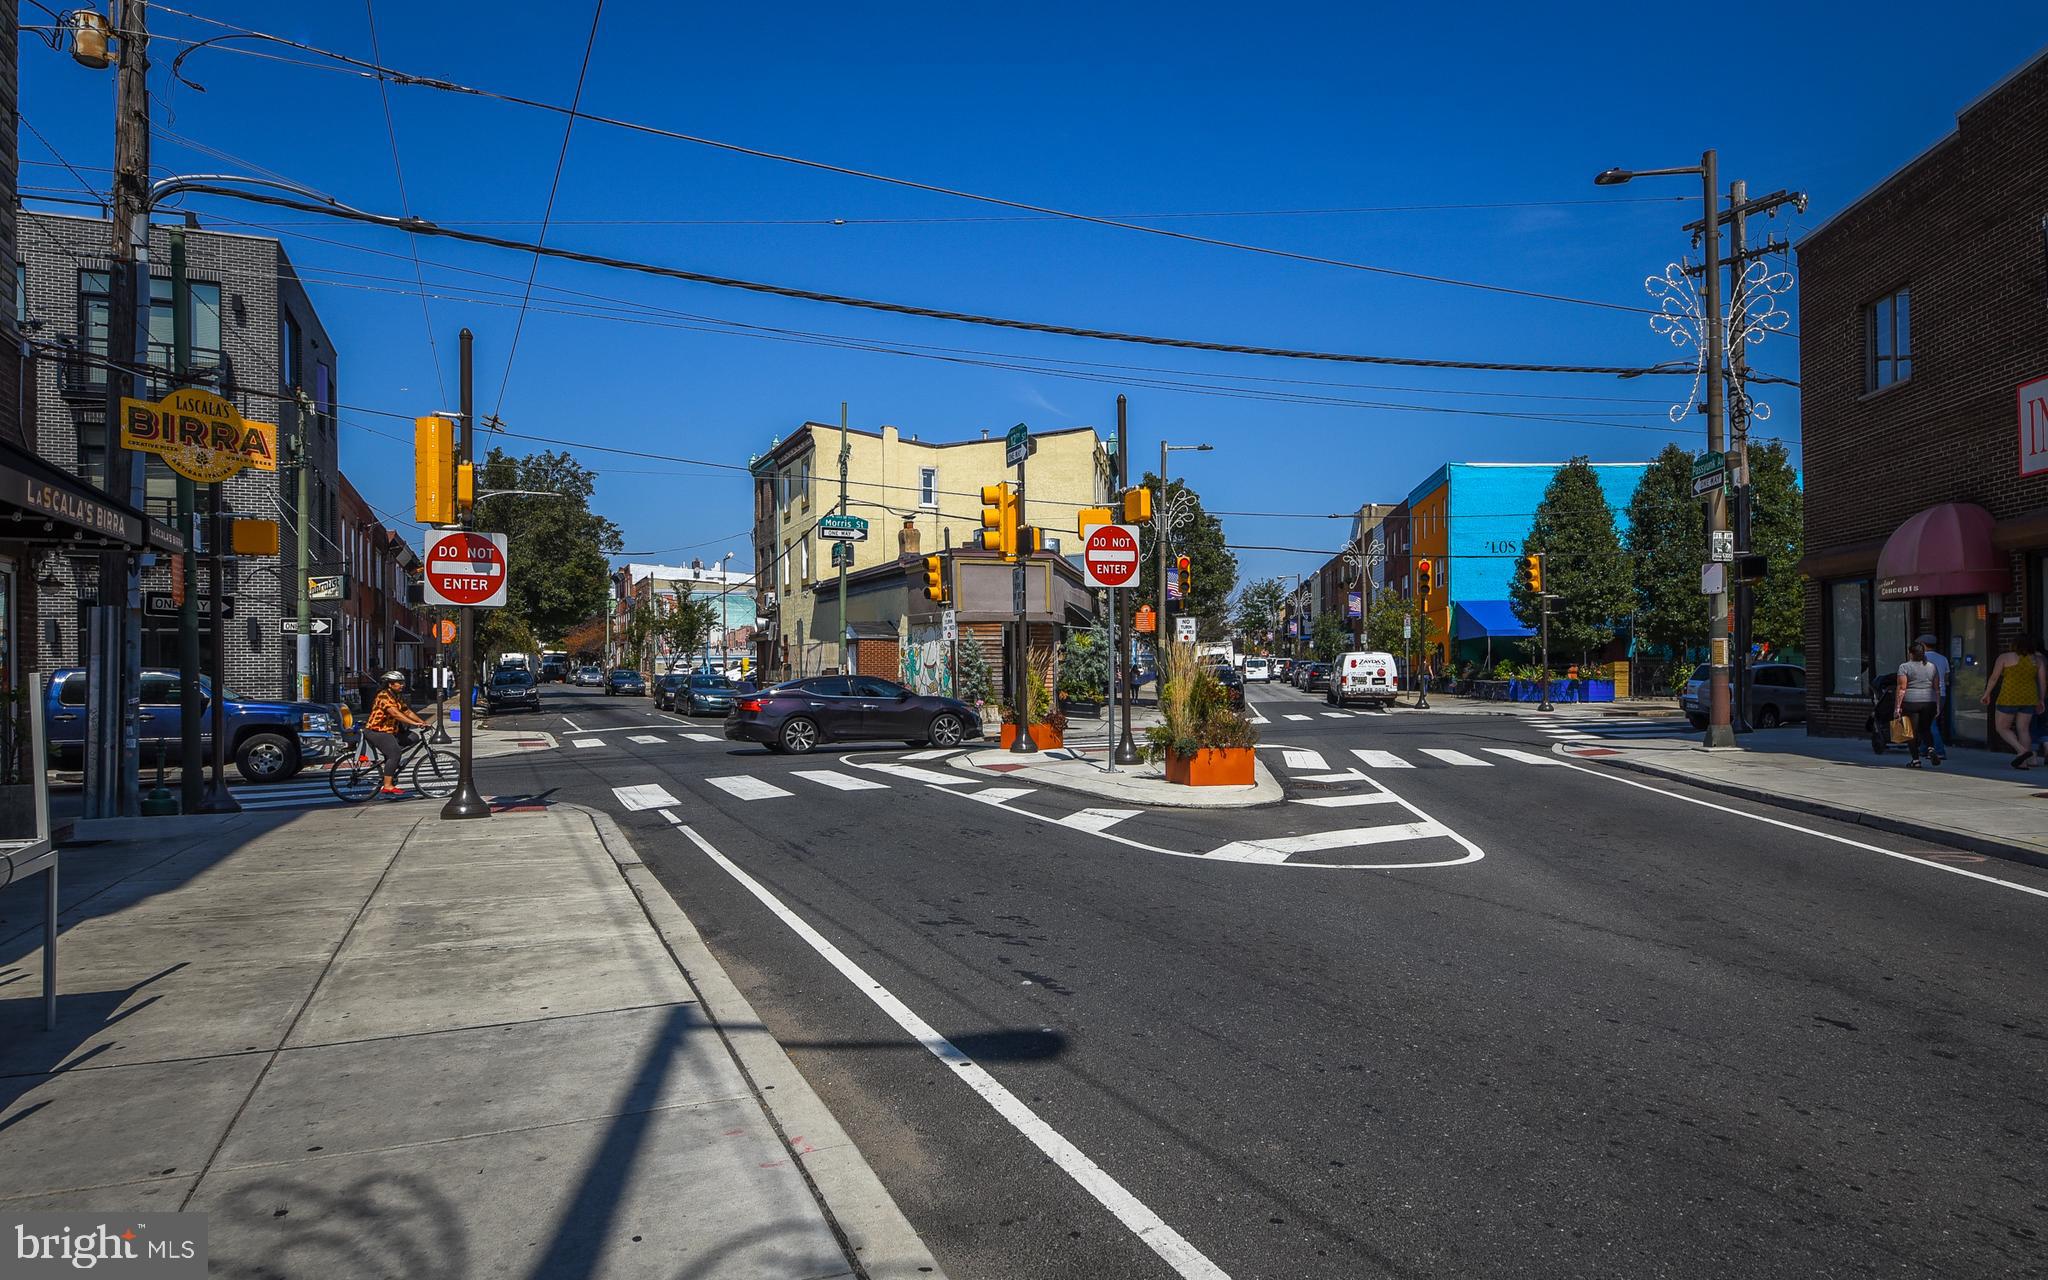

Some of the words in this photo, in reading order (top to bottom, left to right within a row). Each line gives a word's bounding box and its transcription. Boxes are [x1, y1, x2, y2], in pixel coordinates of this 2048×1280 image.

[128, 406, 272, 459] BIRRA
[128, 440, 160, 449] CREATIVE
[225, 455, 249, 463] WORLD
[172, 458, 202, 479] ARTISAN
[205, 466, 233, 479] ITALIAN
[96, 507, 126, 536] BIRRA
[825, 519, 852, 528] Morris
[856, 520, 864, 529] St
[1093, 537, 1107, 547] DO
[1112, 537, 1131, 548] NOT
[438, 545, 458, 558] DO
[467, 547, 495, 559] NOT
[1096, 564, 1127, 574] ENTER
[443, 578, 488, 591] ENTER
